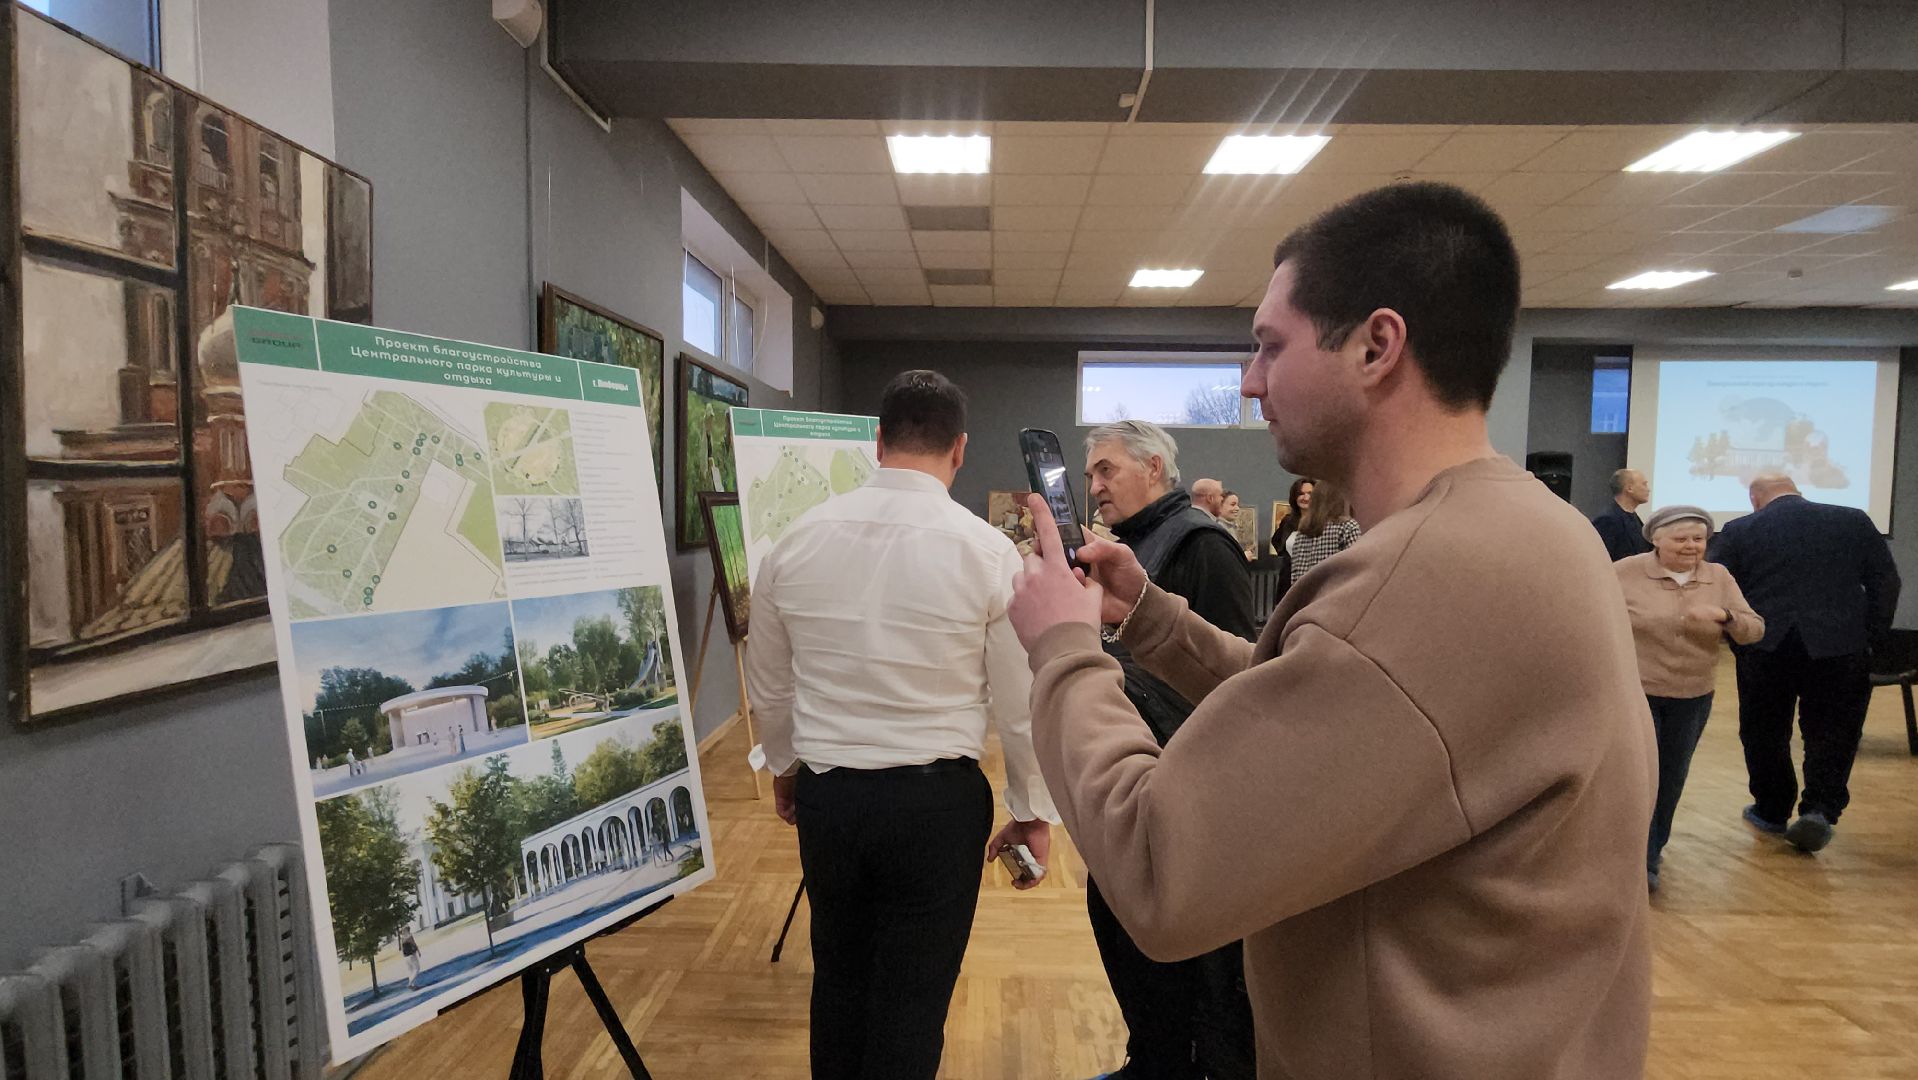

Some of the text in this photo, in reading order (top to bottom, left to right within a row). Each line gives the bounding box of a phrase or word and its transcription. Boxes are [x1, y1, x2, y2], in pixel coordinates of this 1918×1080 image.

[350, 346, 562, 383] Центрального парка культуры и
[375, 336, 542, 369] Проект благоустройства
[443, 373, 492, 385] отдыха
